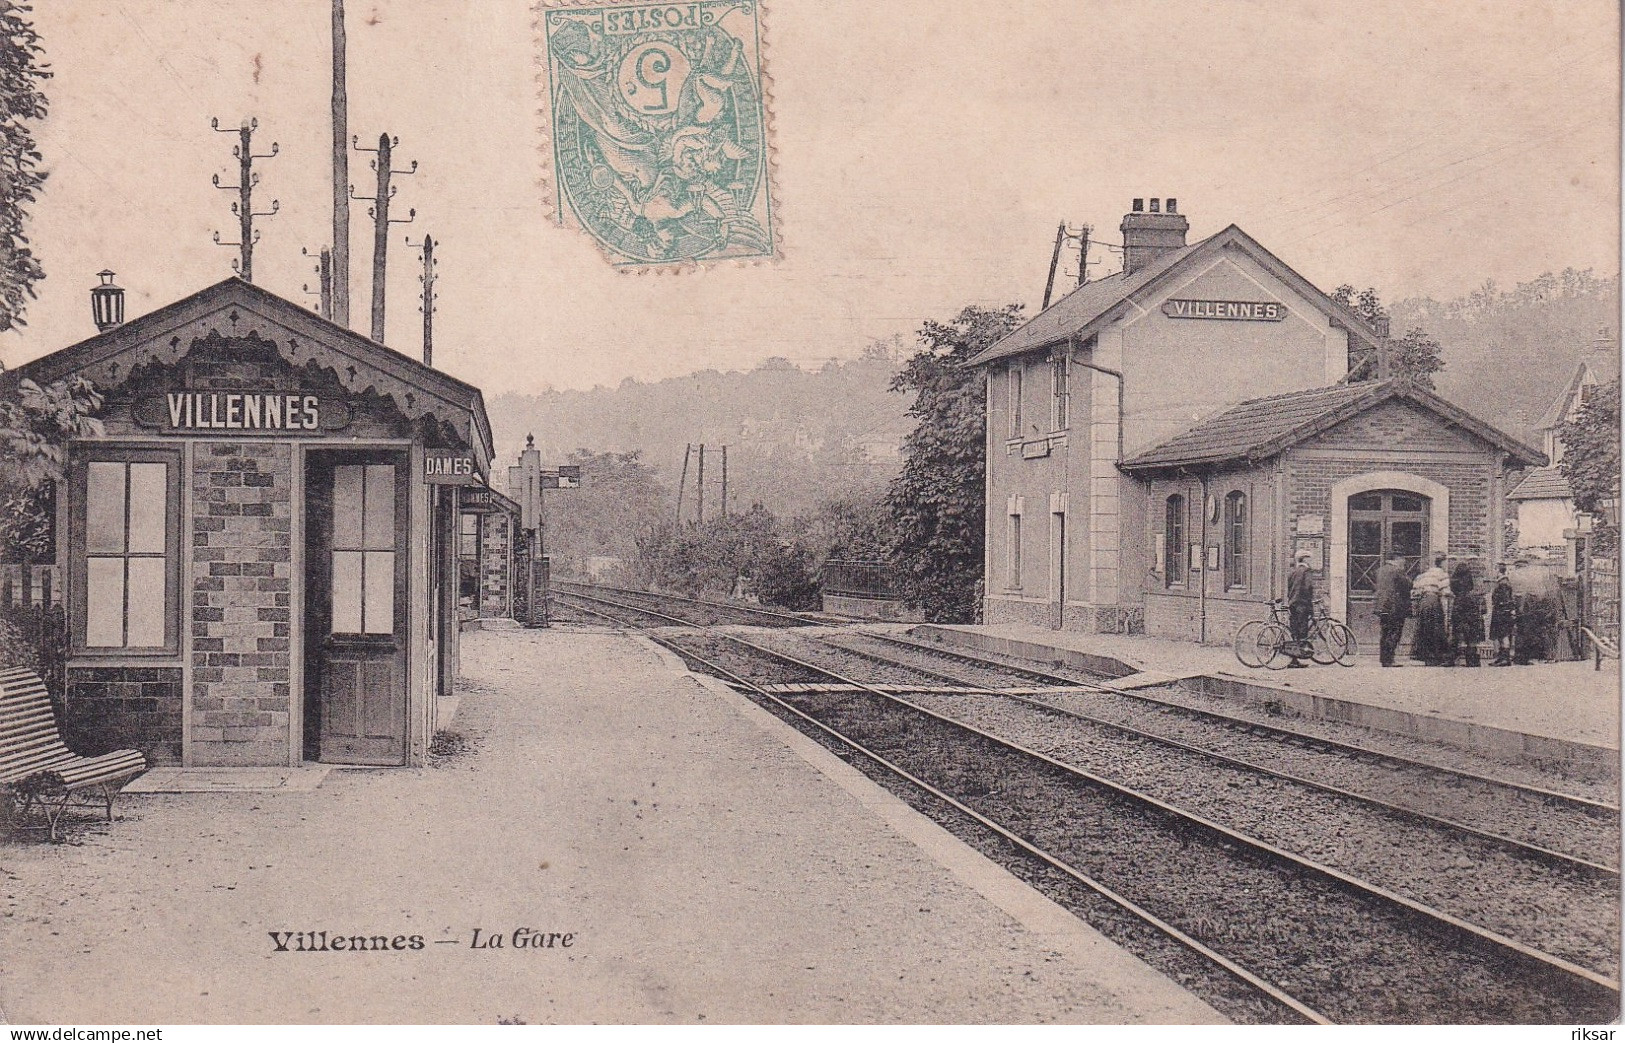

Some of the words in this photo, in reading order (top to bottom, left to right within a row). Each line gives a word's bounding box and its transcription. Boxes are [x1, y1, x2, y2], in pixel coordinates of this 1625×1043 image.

[607, 6, 697, 31] POSTES
[1174, 301, 1278, 318] VILLENNES
[167, 393, 319, 430] VILLENNES
[426, 457, 472, 475] DAMES
